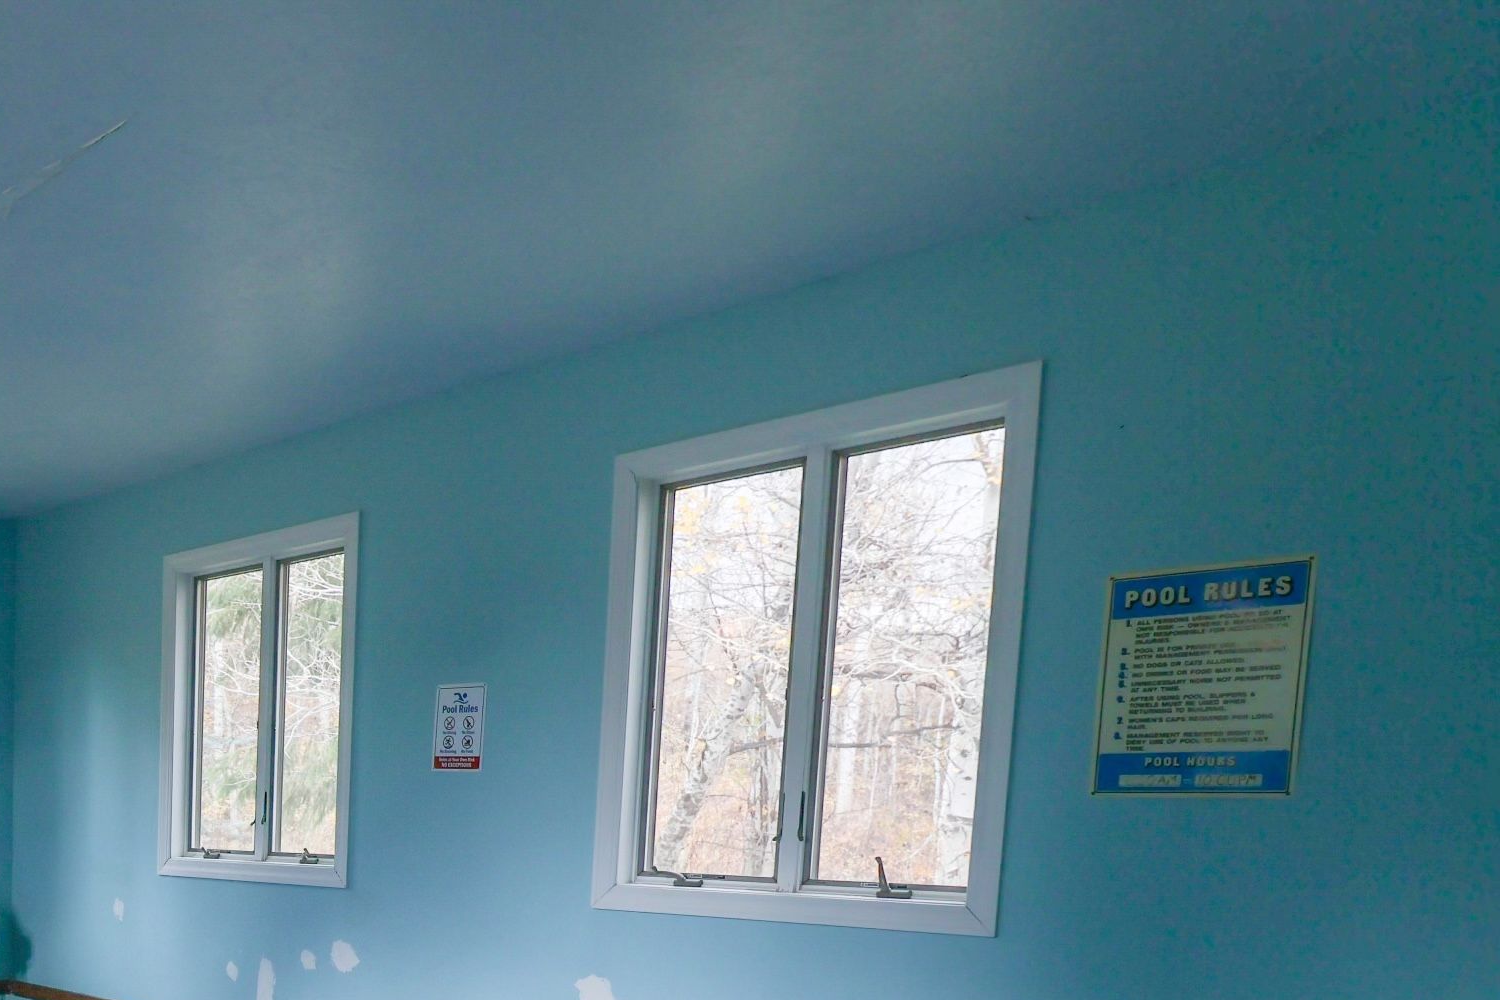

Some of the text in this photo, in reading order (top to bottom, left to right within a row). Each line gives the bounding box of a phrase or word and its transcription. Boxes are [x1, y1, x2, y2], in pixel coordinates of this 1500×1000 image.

[1125, 575, 1292, 609] POOL RULES
[442, 704, 478, 713] Pool Rules
[1144, 756, 1236, 767] POOL HOURS
